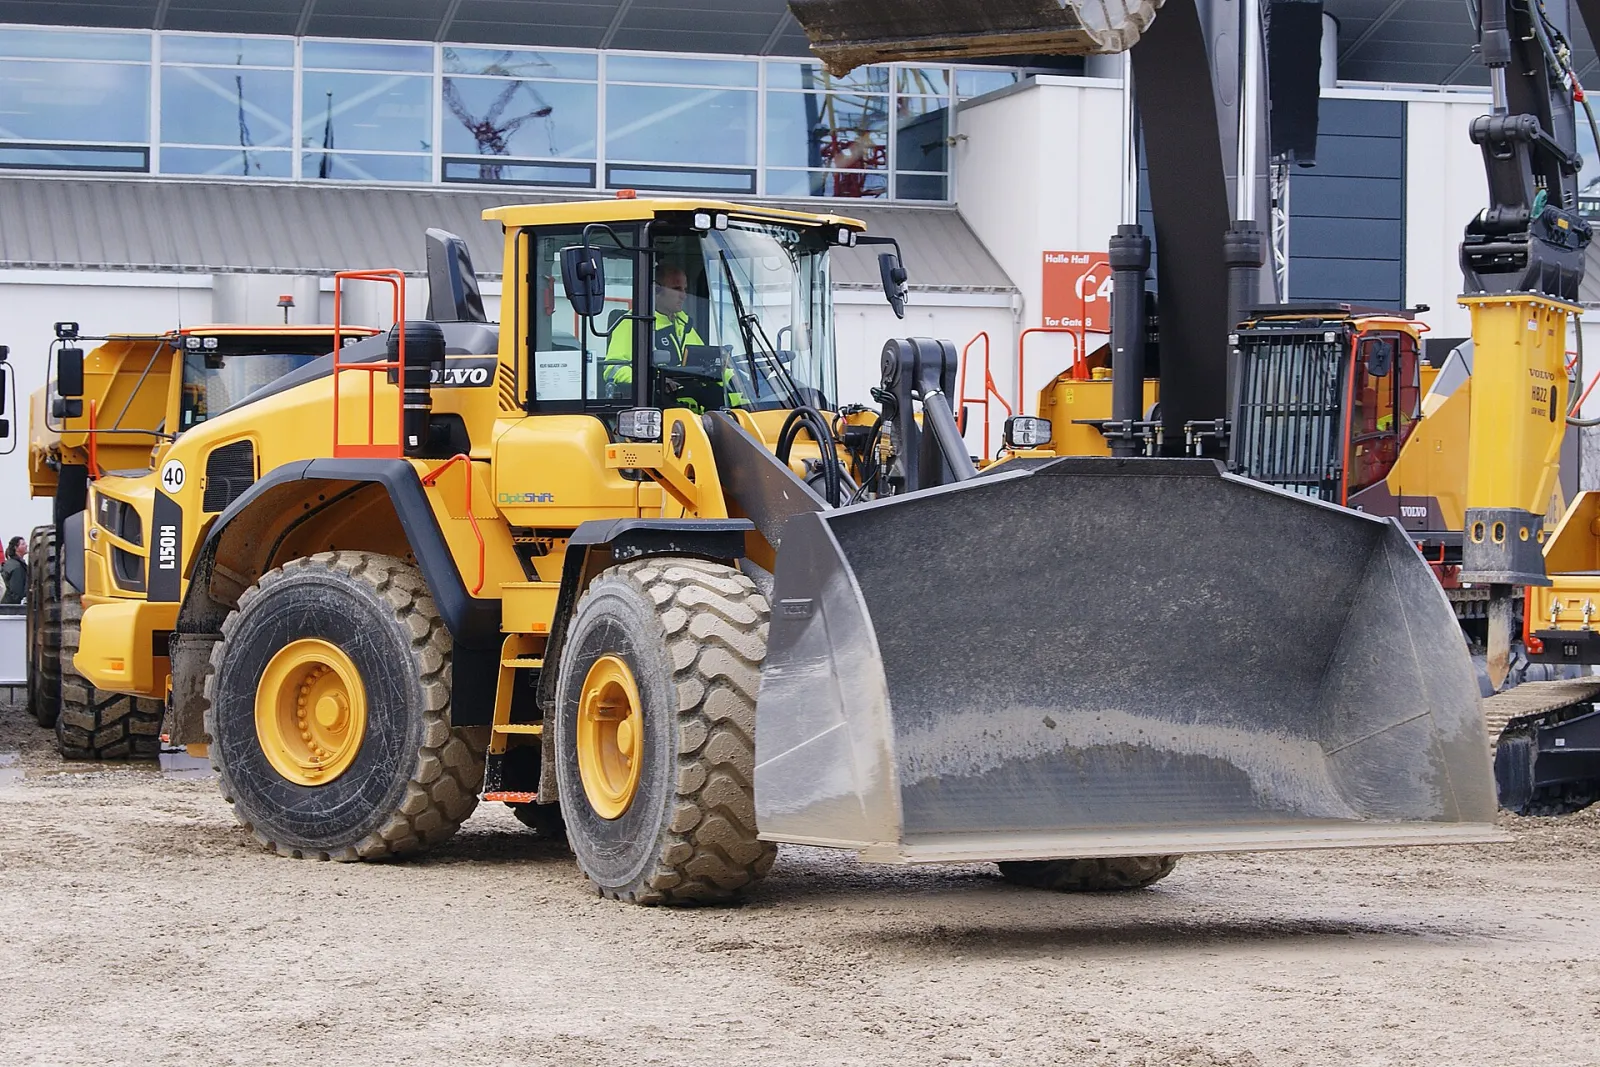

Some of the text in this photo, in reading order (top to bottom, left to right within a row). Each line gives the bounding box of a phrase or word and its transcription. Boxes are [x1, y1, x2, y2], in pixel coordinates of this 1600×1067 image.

[1045, 254, 1090, 264] Halle Hall
[1075, 274, 1114, 303] C4
[1045, 316, 1060, 326] Tor
[1529, 368, 1555, 381] VOLVO
[163, 467, 184, 486] 40
[1400, 506, 1427, 517] VOLVO
[159, 525, 176, 570] L150H
